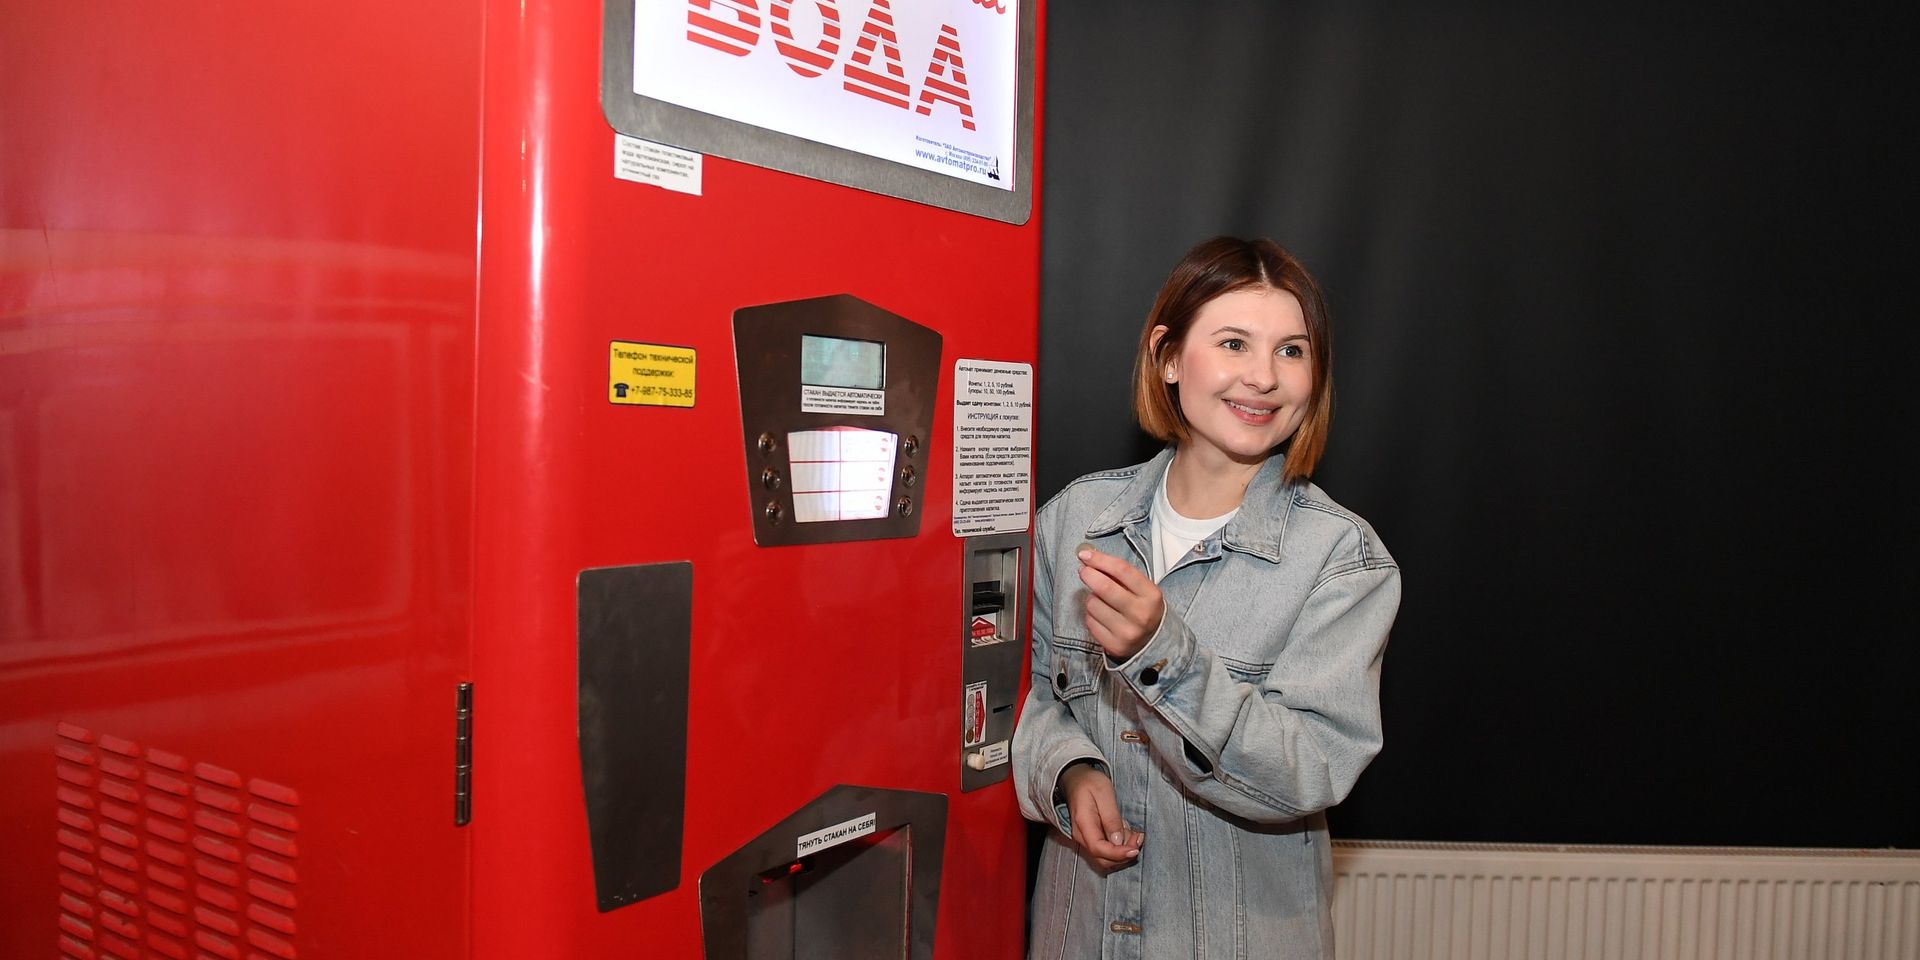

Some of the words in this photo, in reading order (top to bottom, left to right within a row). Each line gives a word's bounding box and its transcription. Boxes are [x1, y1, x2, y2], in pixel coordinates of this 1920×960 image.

[915, 149, 986, 175] www.avtomatpro.ru
[614, 349, 647, 360] Телефон
[649, 353, 693, 364] технической
[799, 837, 822, 851] ТЯНУТЬ
[823, 829, 847, 842] СТАКАН
[848, 826, 856, 834] НА
